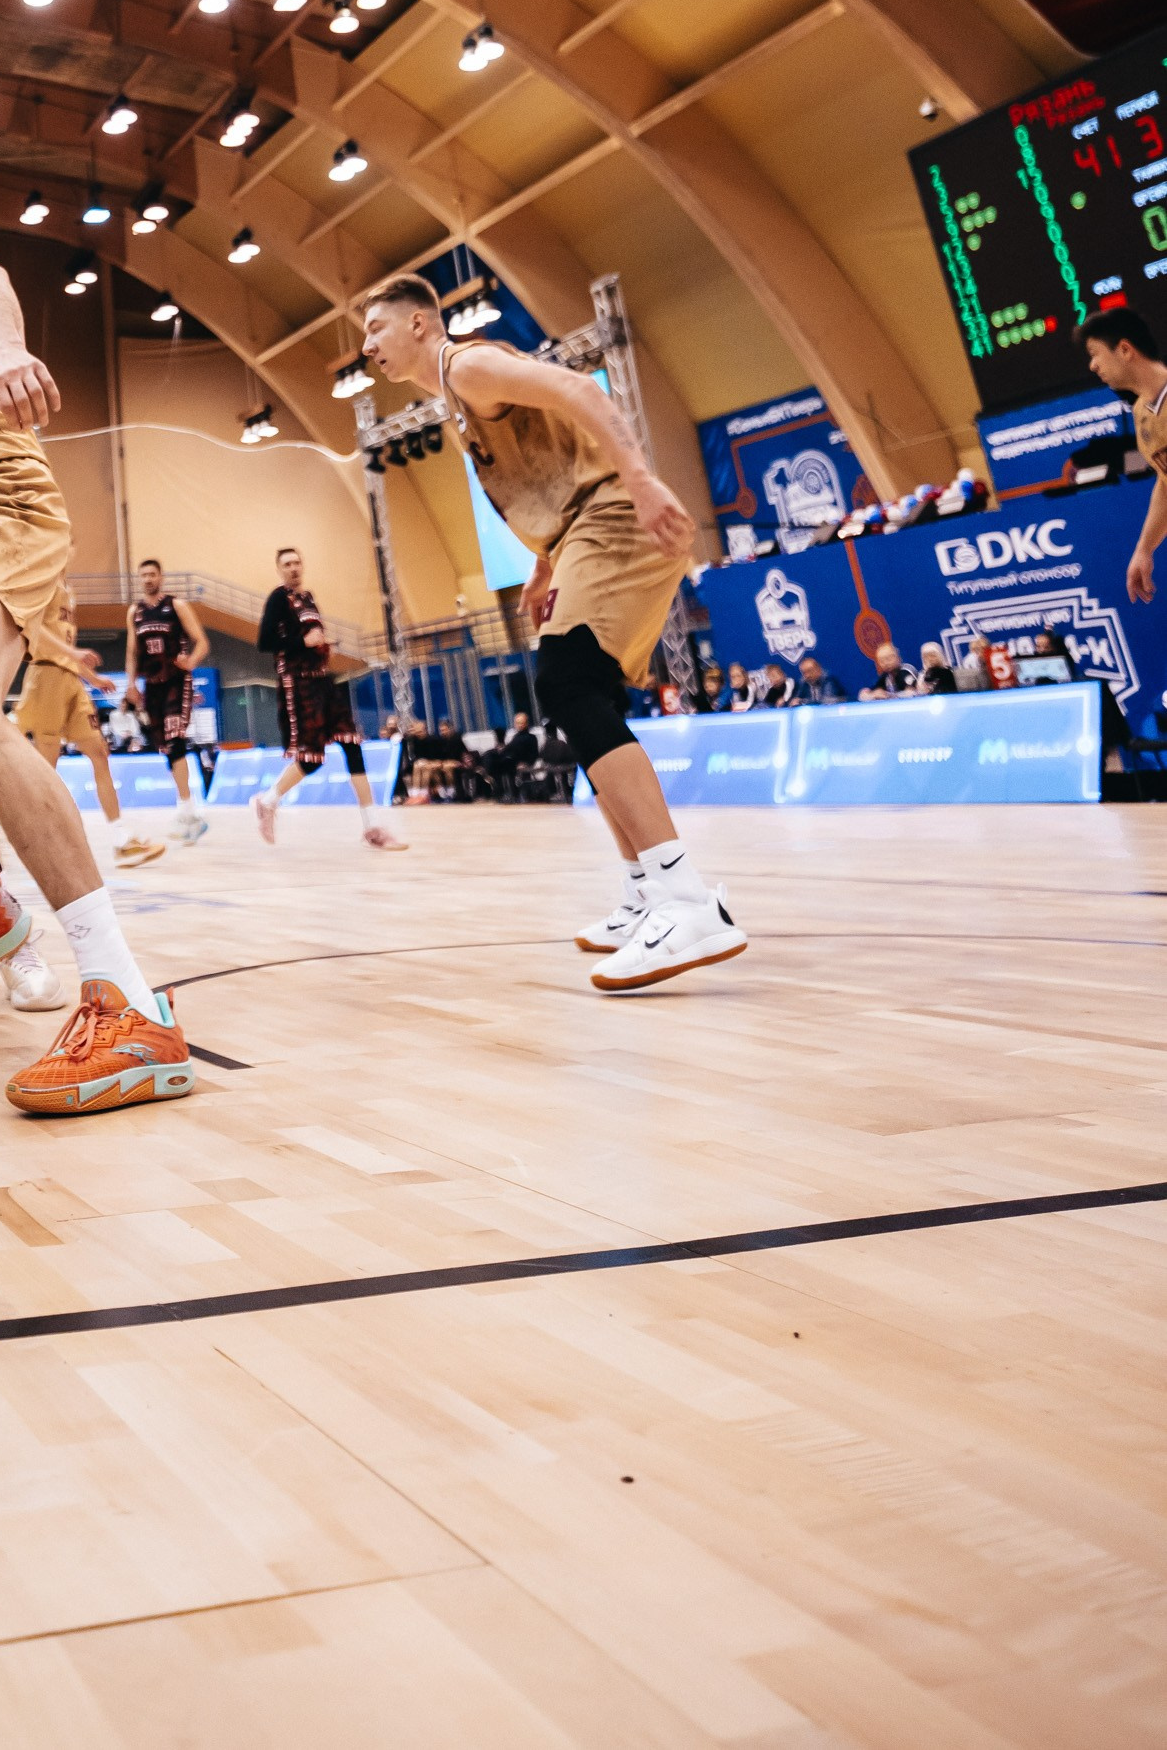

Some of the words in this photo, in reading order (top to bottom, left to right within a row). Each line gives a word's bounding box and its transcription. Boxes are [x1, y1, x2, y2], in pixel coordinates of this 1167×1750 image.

[1135, 115, 1164, 159] 3
[976, 518, 1074, 570] DKC
[990, 652, 1012, 681] 5
